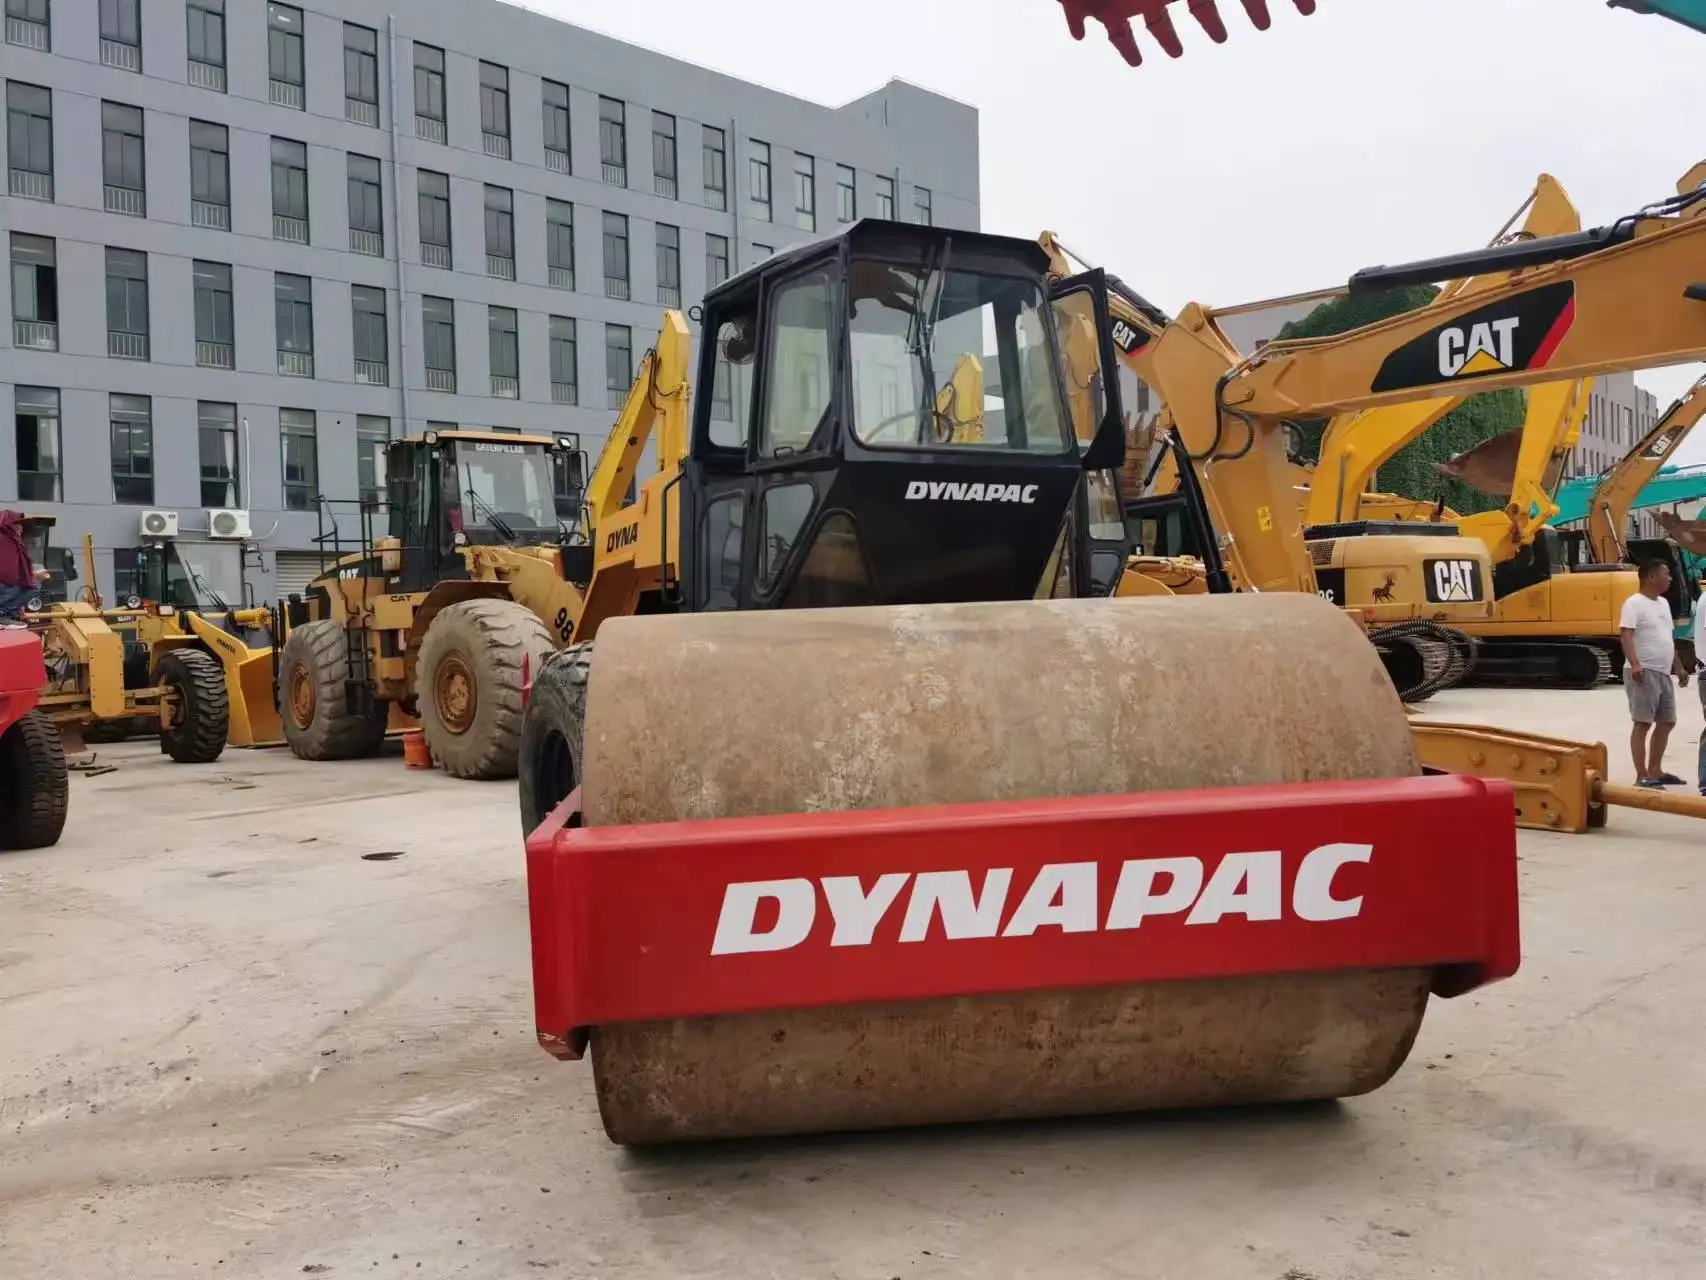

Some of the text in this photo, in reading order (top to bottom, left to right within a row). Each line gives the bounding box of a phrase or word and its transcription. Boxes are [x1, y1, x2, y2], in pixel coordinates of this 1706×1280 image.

[1112, 321, 1137, 350] CAT
[1438, 316, 1519, 377] CAT
[1651, 434, 1671, 455] CAT
[904, 481, 1039, 503] DYNAPAC
[606, 521, 639, 554] DYNA
[1433, 561, 1474, 601] CAT
[390, 594, 413, 603] CAT
[711, 842, 1373, 955] DYNAPAC
